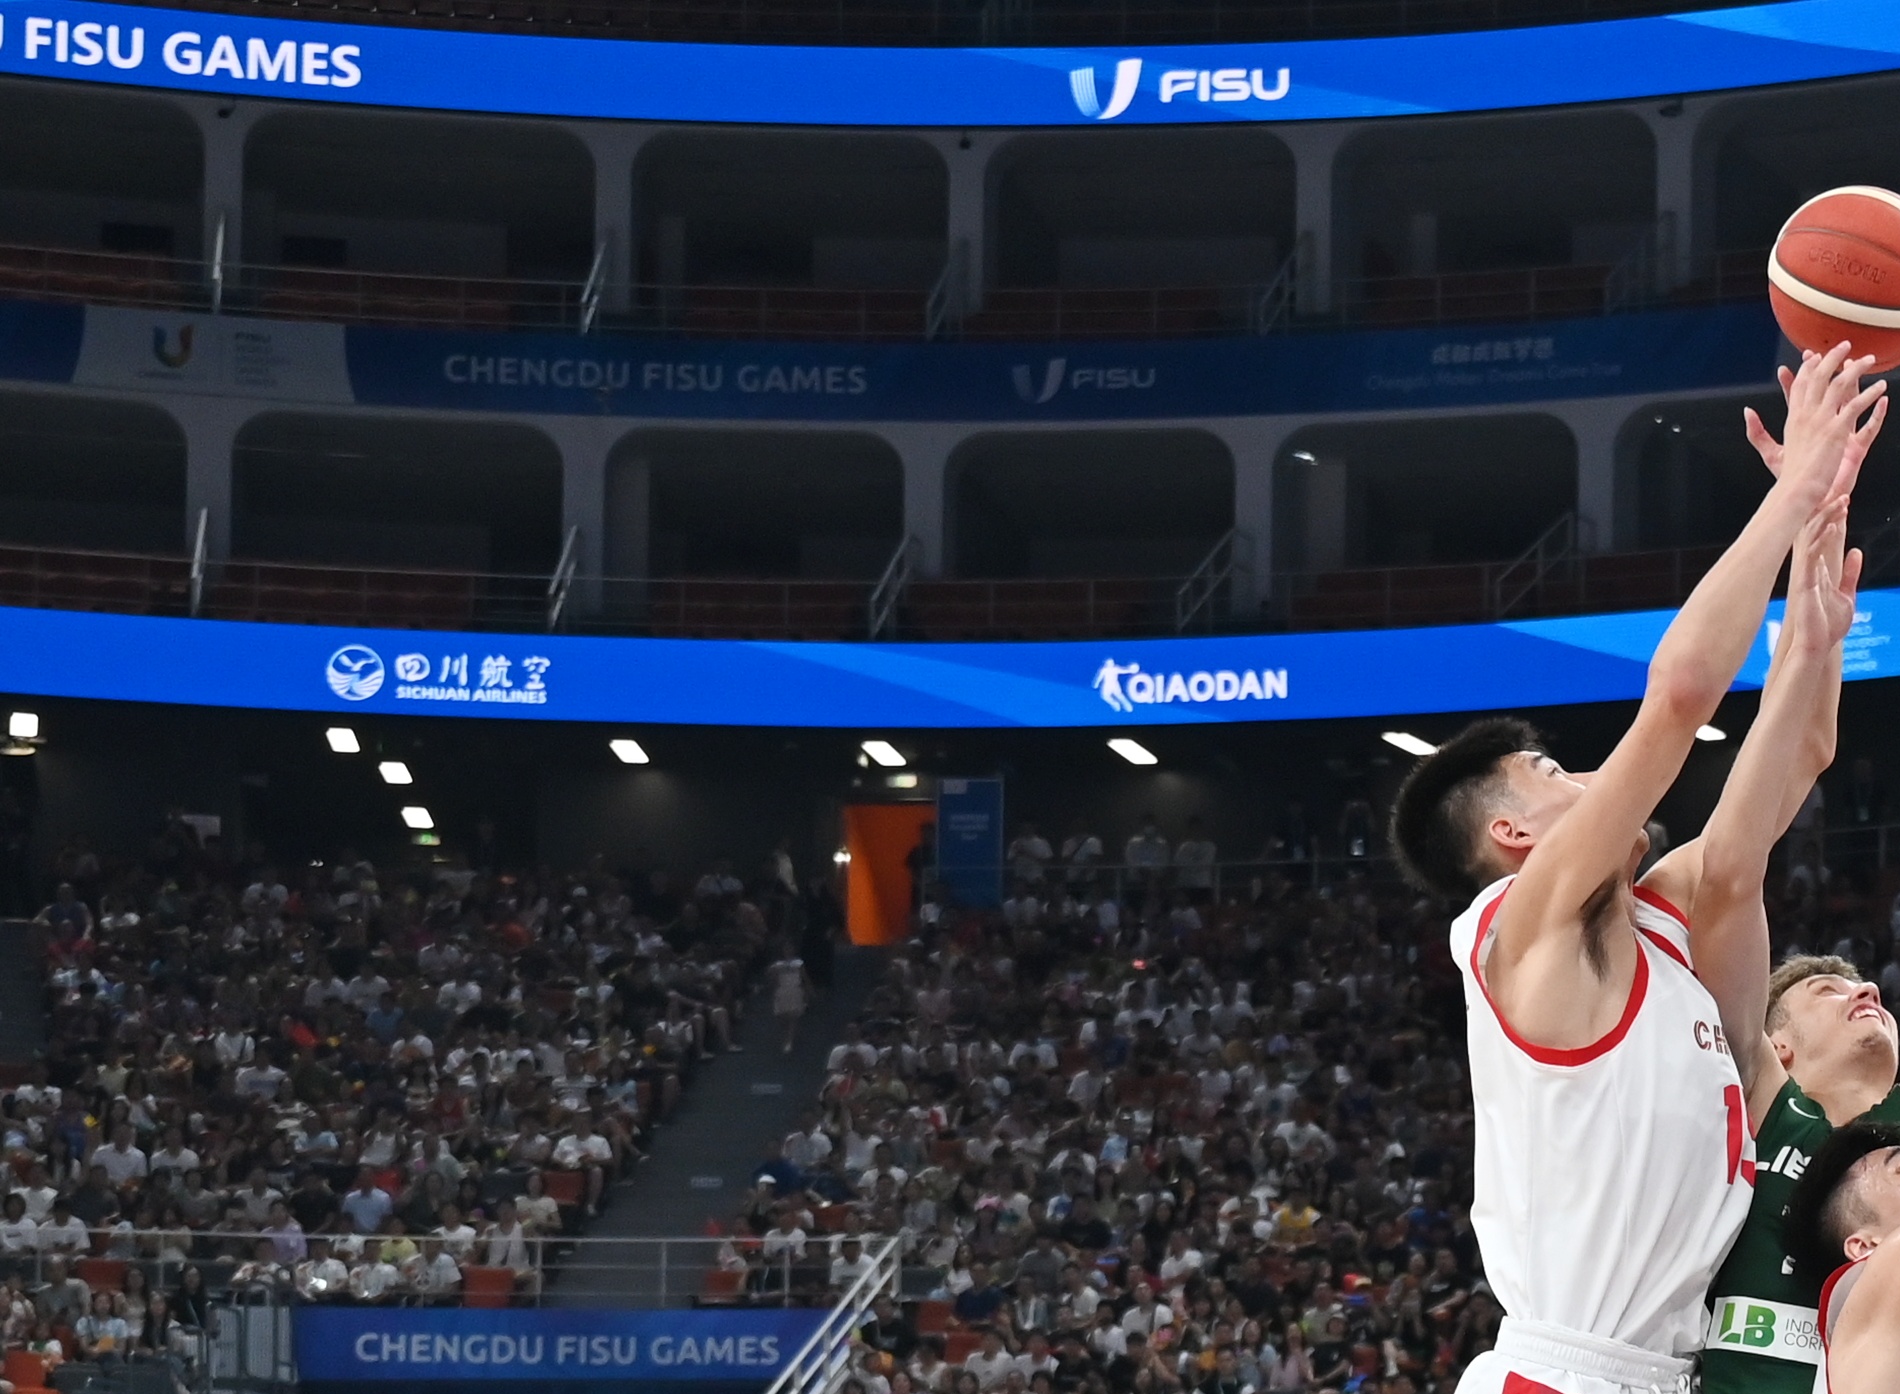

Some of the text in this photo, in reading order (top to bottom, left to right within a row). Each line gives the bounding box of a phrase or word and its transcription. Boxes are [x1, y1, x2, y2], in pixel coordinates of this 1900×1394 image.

[24, 16, 144, 69] FISU
[162, 31, 362, 88] GAMES
[1159, 67, 1291, 103] FISU
[443, 354, 867, 395] CHENGDU FISU GAMES
[1072, 367, 1156, 390] FISU
[395, 652, 551, 689] 四川航空
[1127, 669, 1288, 704] QIAODAN
[396, 686, 547, 704] SICHUAN AIRLINES
[1719, 1303, 1776, 1347] LB
[355, 1332, 780, 1366] CHENGDU FISU GAMES
